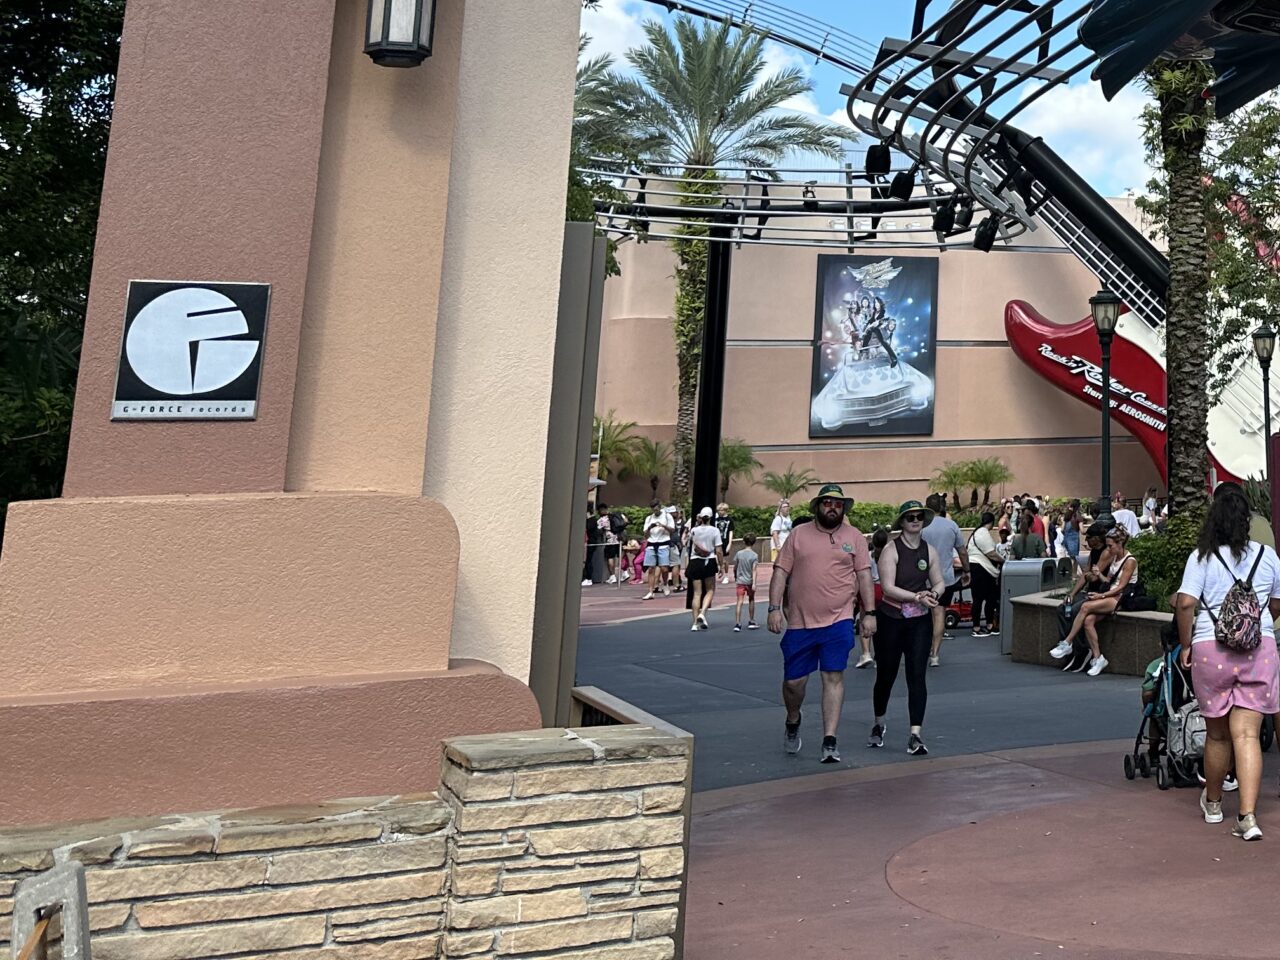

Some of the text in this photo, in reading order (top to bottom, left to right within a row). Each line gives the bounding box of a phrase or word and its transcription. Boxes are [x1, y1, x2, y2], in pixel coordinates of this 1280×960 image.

[1070, 355, 1133, 396] Roler
[1130, 392, 1167, 417] Coaste
[1118, 403, 1167, 431] AEROSMITH
